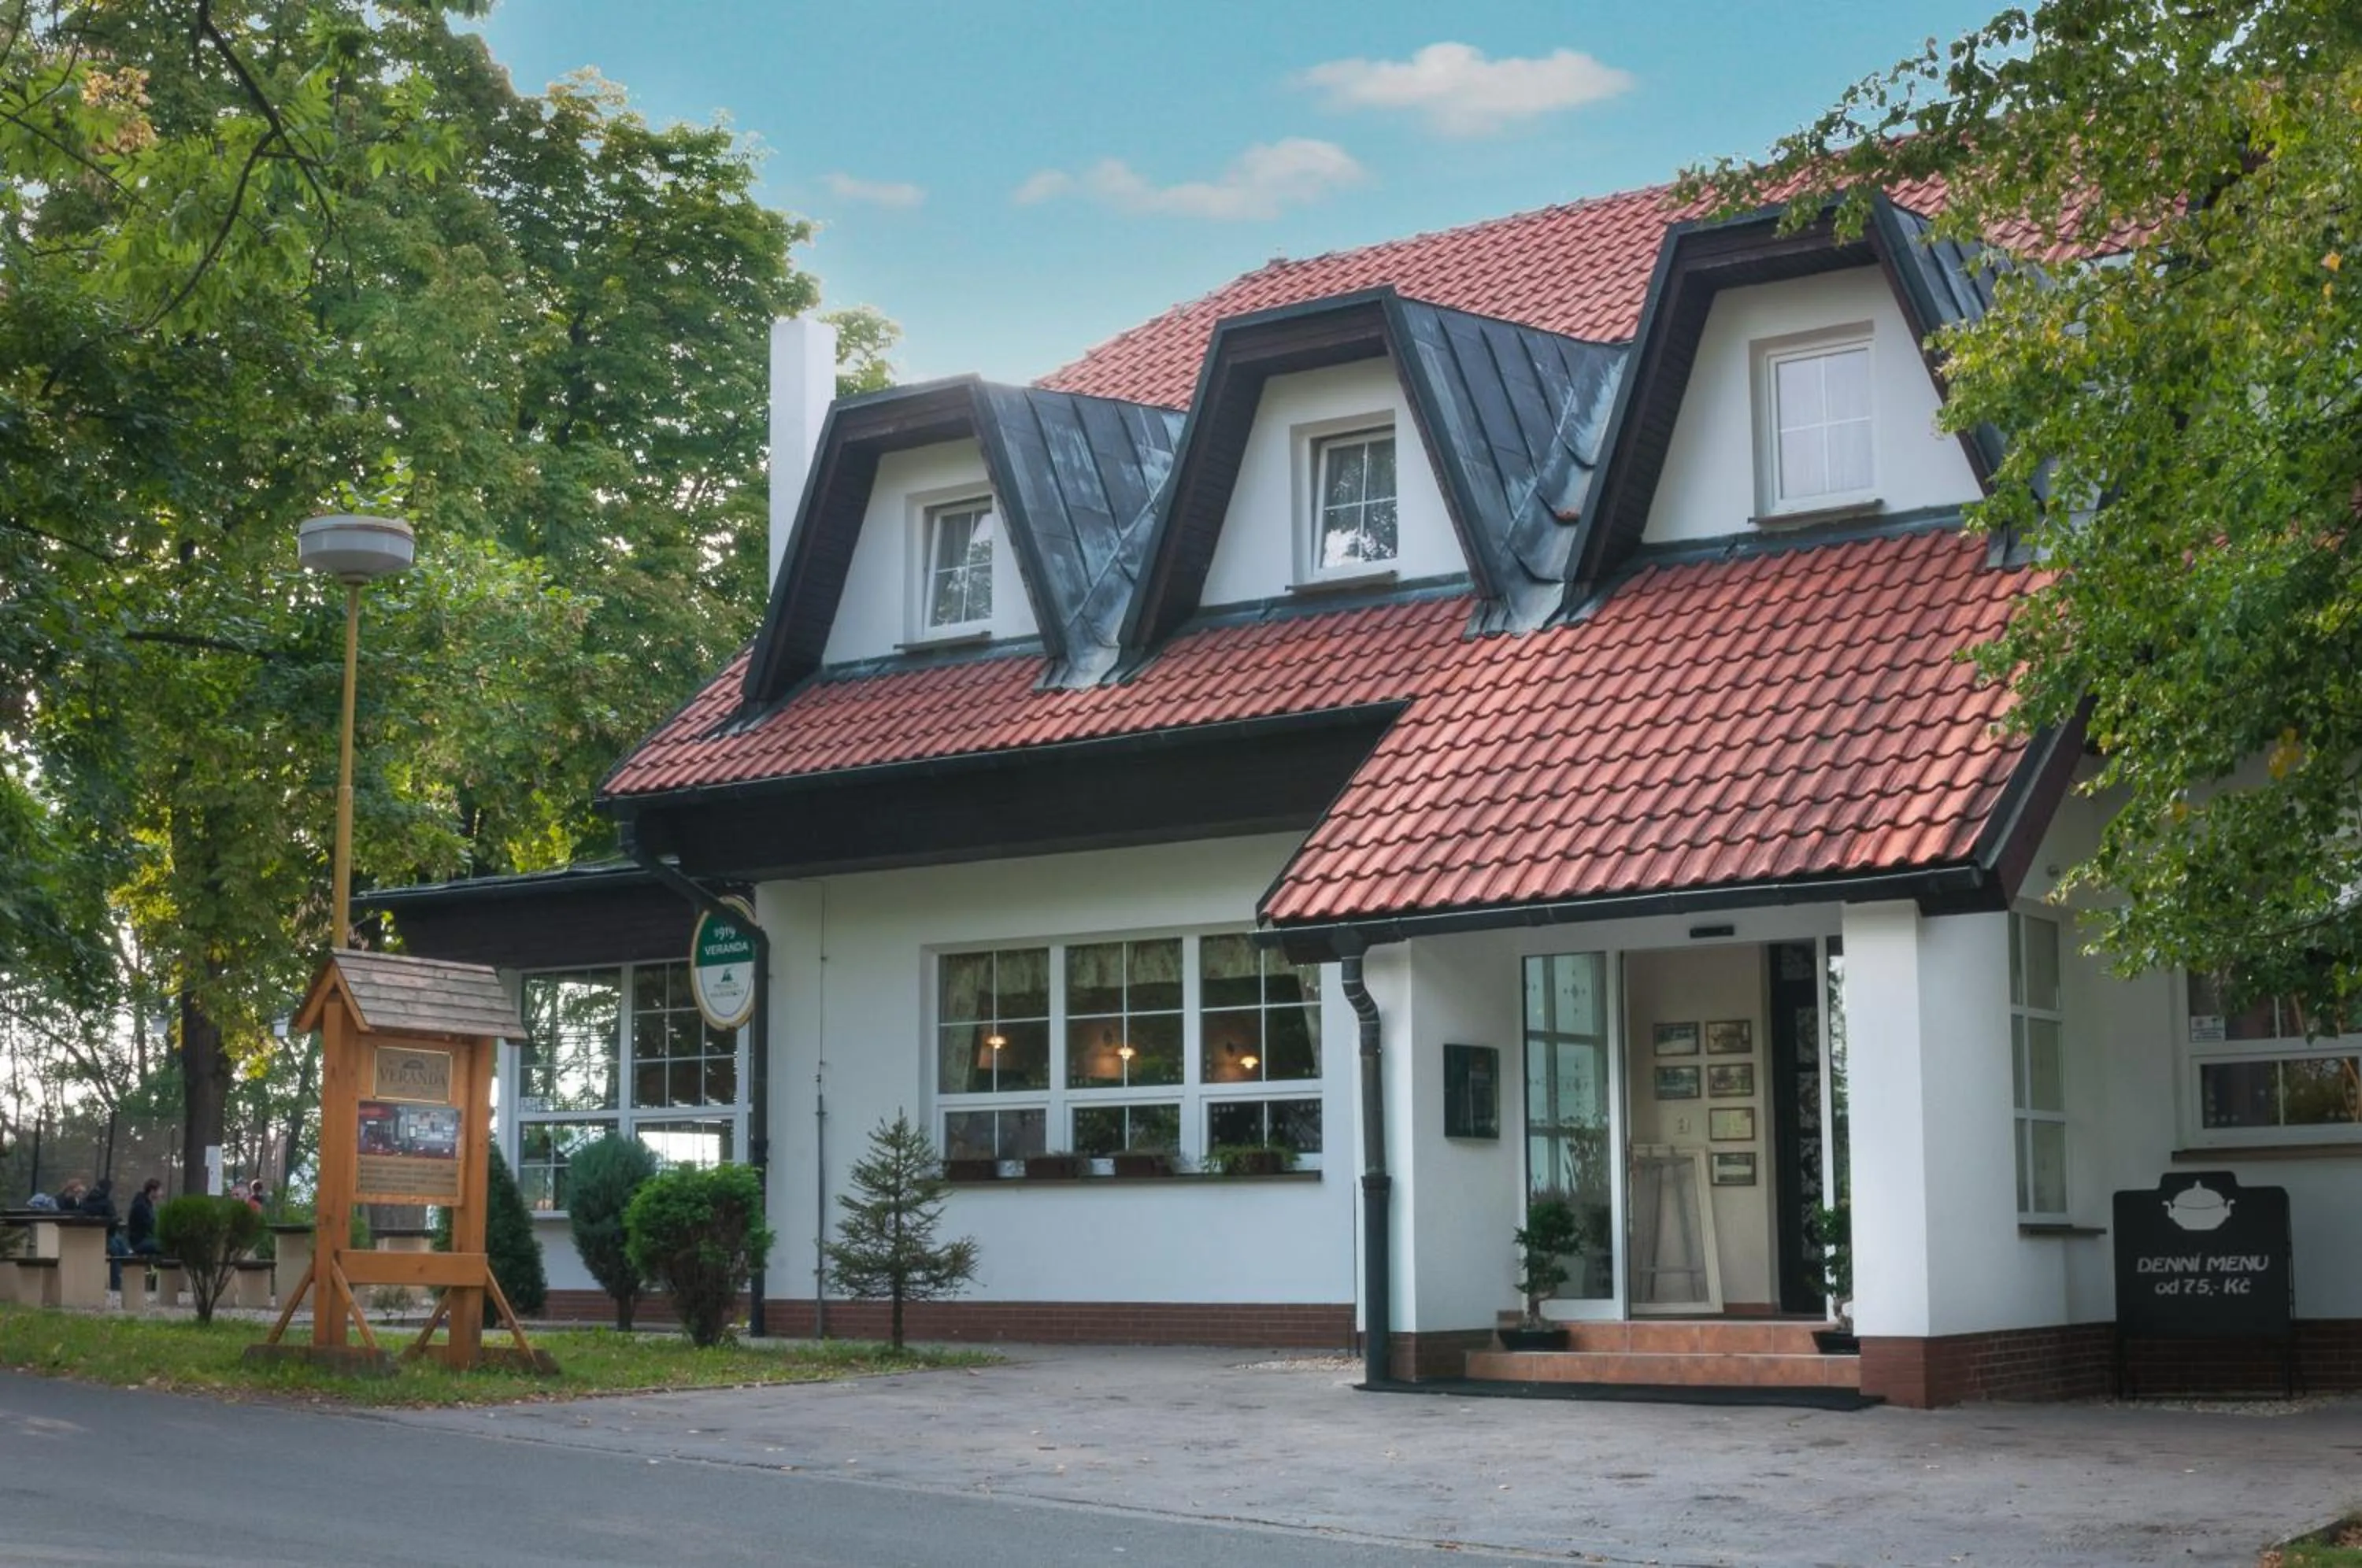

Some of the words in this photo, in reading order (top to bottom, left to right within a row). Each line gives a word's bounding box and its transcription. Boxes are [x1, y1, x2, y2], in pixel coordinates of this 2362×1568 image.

[705, 941, 749, 956] VERANDA
[379, 1067, 447, 1088] VERANDA
[2206, 1255, 2269, 1272] MENU
[2154, 1278, 2179, 1295] od
